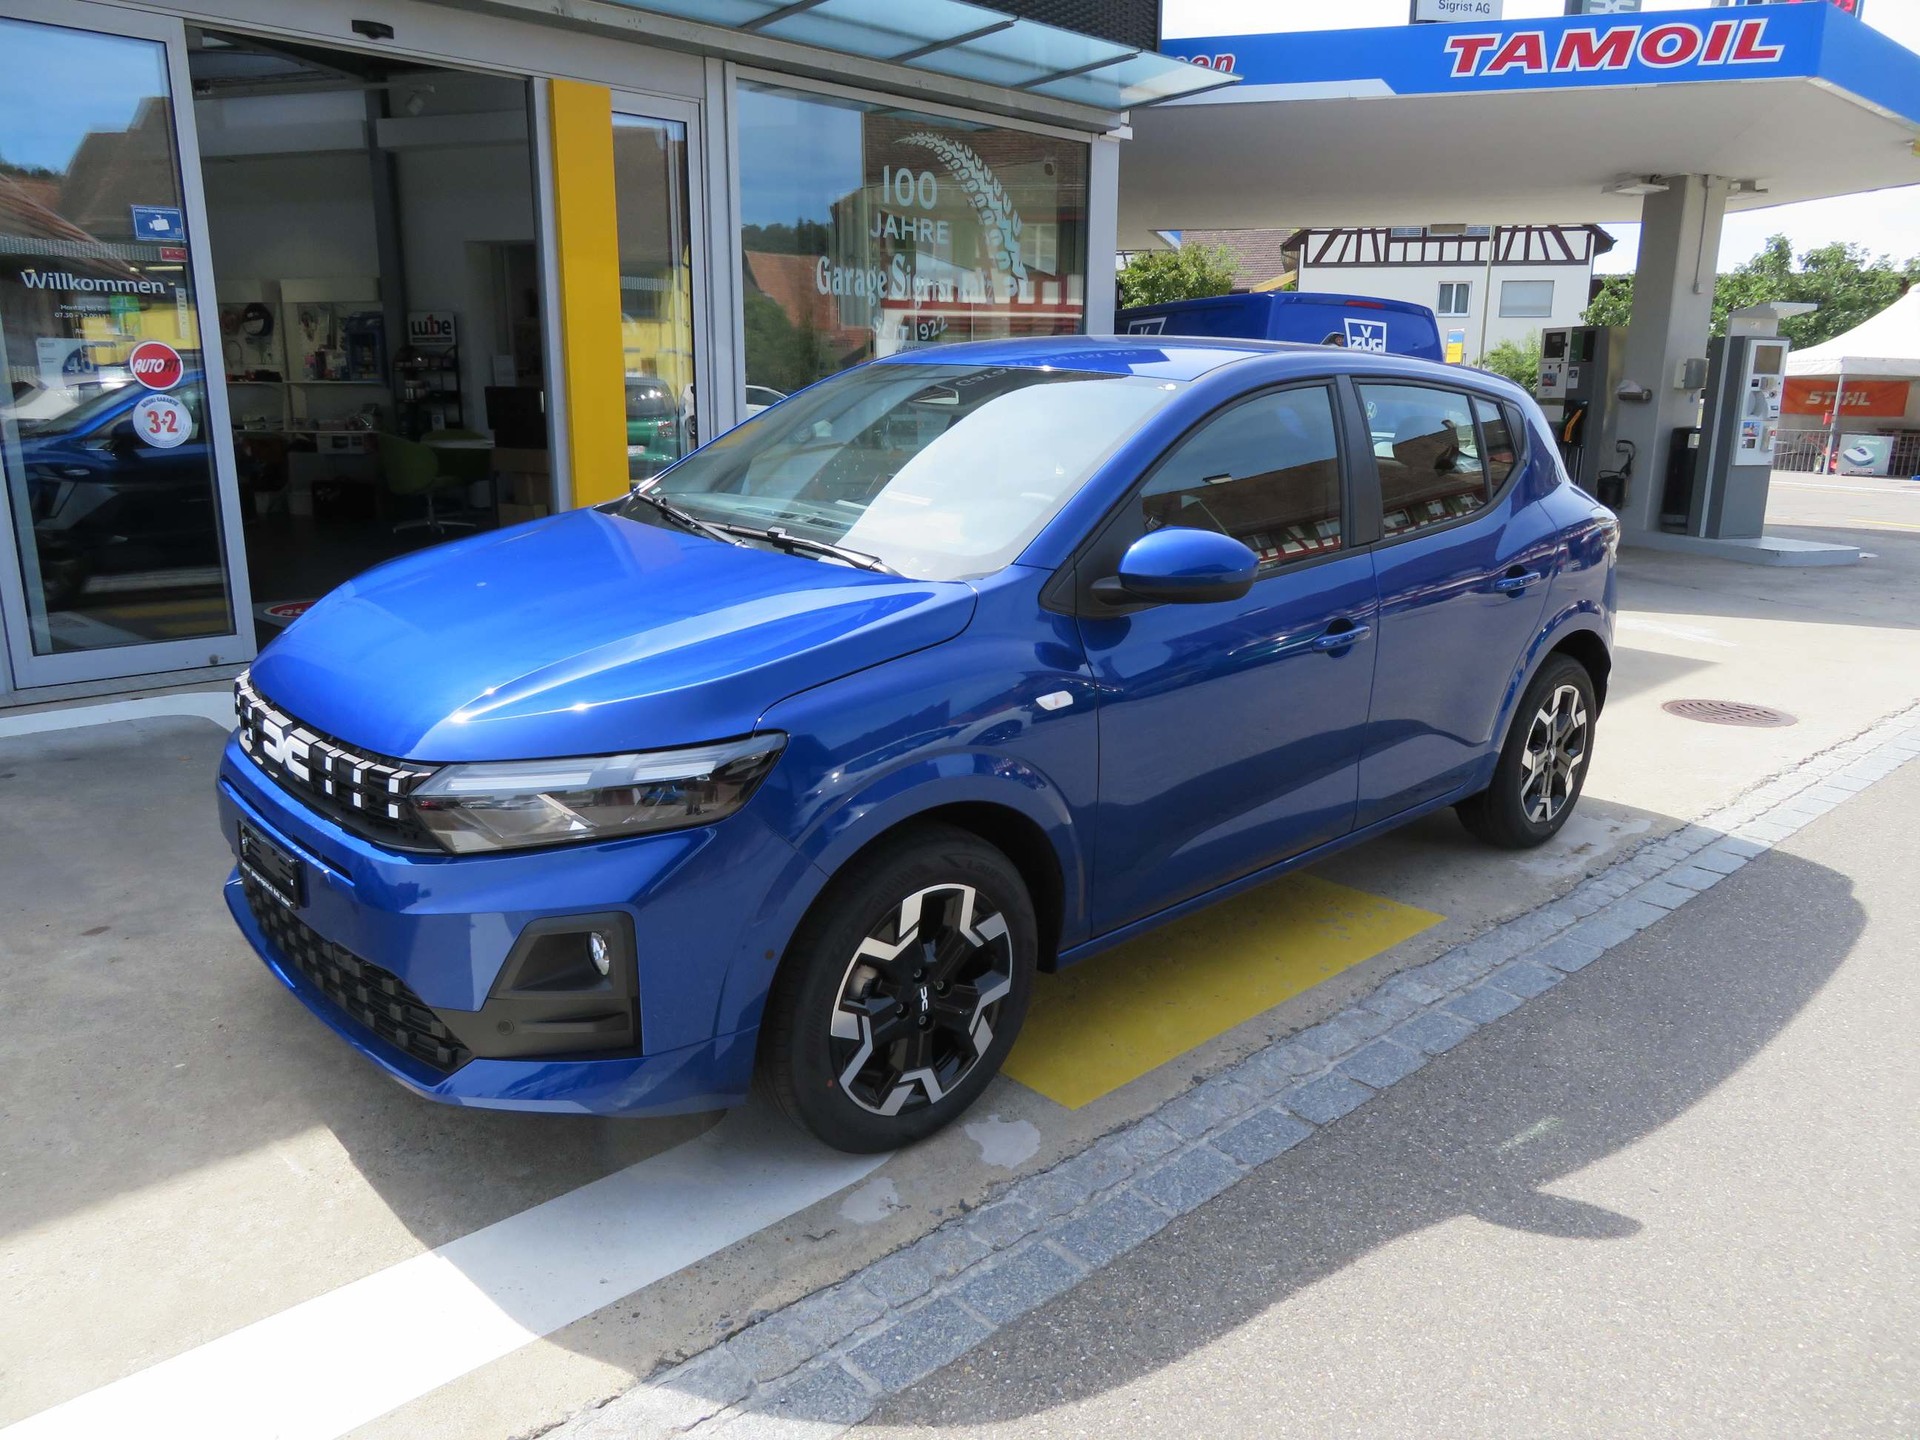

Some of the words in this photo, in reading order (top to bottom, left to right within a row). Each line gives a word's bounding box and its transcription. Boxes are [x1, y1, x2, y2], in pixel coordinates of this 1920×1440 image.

[1438, 0, 1473, 13] Sigrist
[1475, 2, 1491, 14] AG
[1445, 18, 1785, 77] TAMOIL
[881, 165, 938, 209] 100
[870, 212, 949, 245] JAHRE
[20, 271, 166, 294] Willkommen
[816, 255, 888, 307] Garage
[1351, 336, 1382, 352] ZUG
[1806, 391, 1871, 406] STHL
